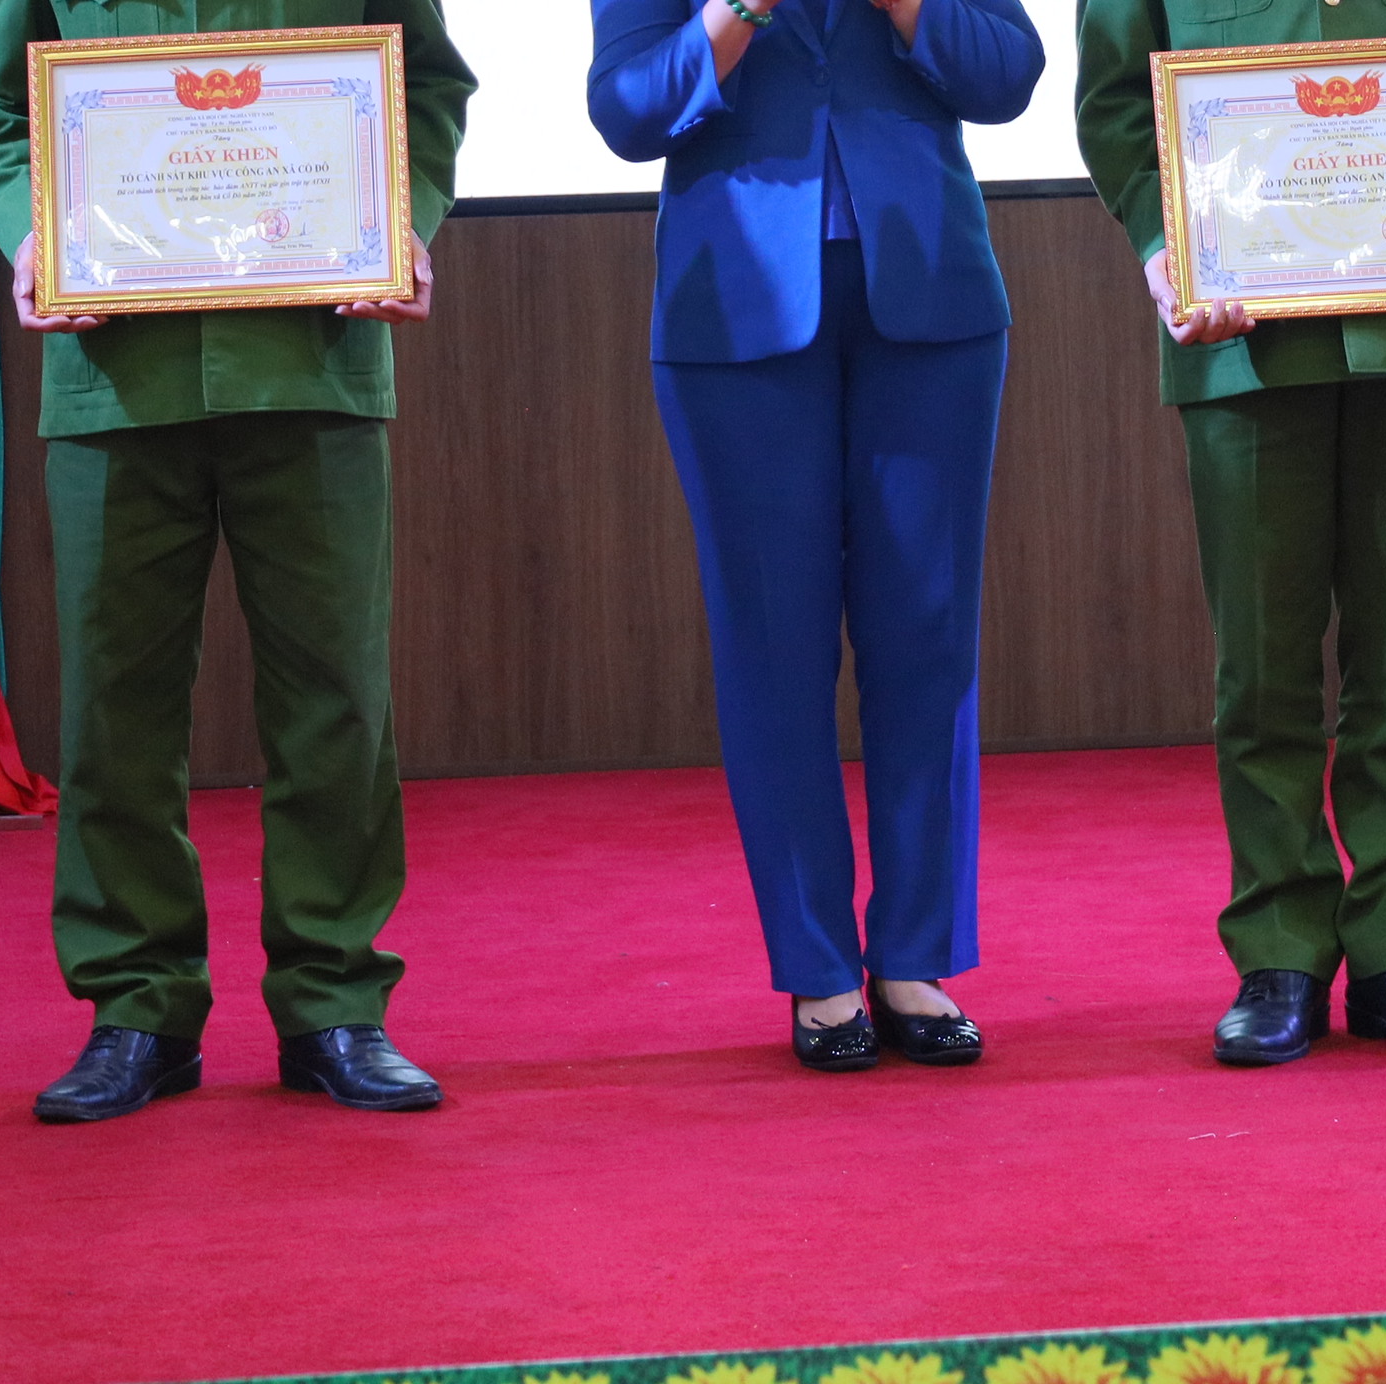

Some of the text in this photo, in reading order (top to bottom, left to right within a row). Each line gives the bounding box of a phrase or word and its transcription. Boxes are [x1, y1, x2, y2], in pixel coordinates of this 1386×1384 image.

[169, 145, 279, 164] GIẤY KHEN
[1293, 151, 1340, 171] GIẤY
[188, 170, 209, 180] KHU
[235, 166, 264, 177] CÔNG
[266, 166, 280, 176] AN
[1309, 175, 1333, 188] HỢP
[1335, 171, 1368, 185] CÔNG
[1370, 172, 1385, 182] AN
